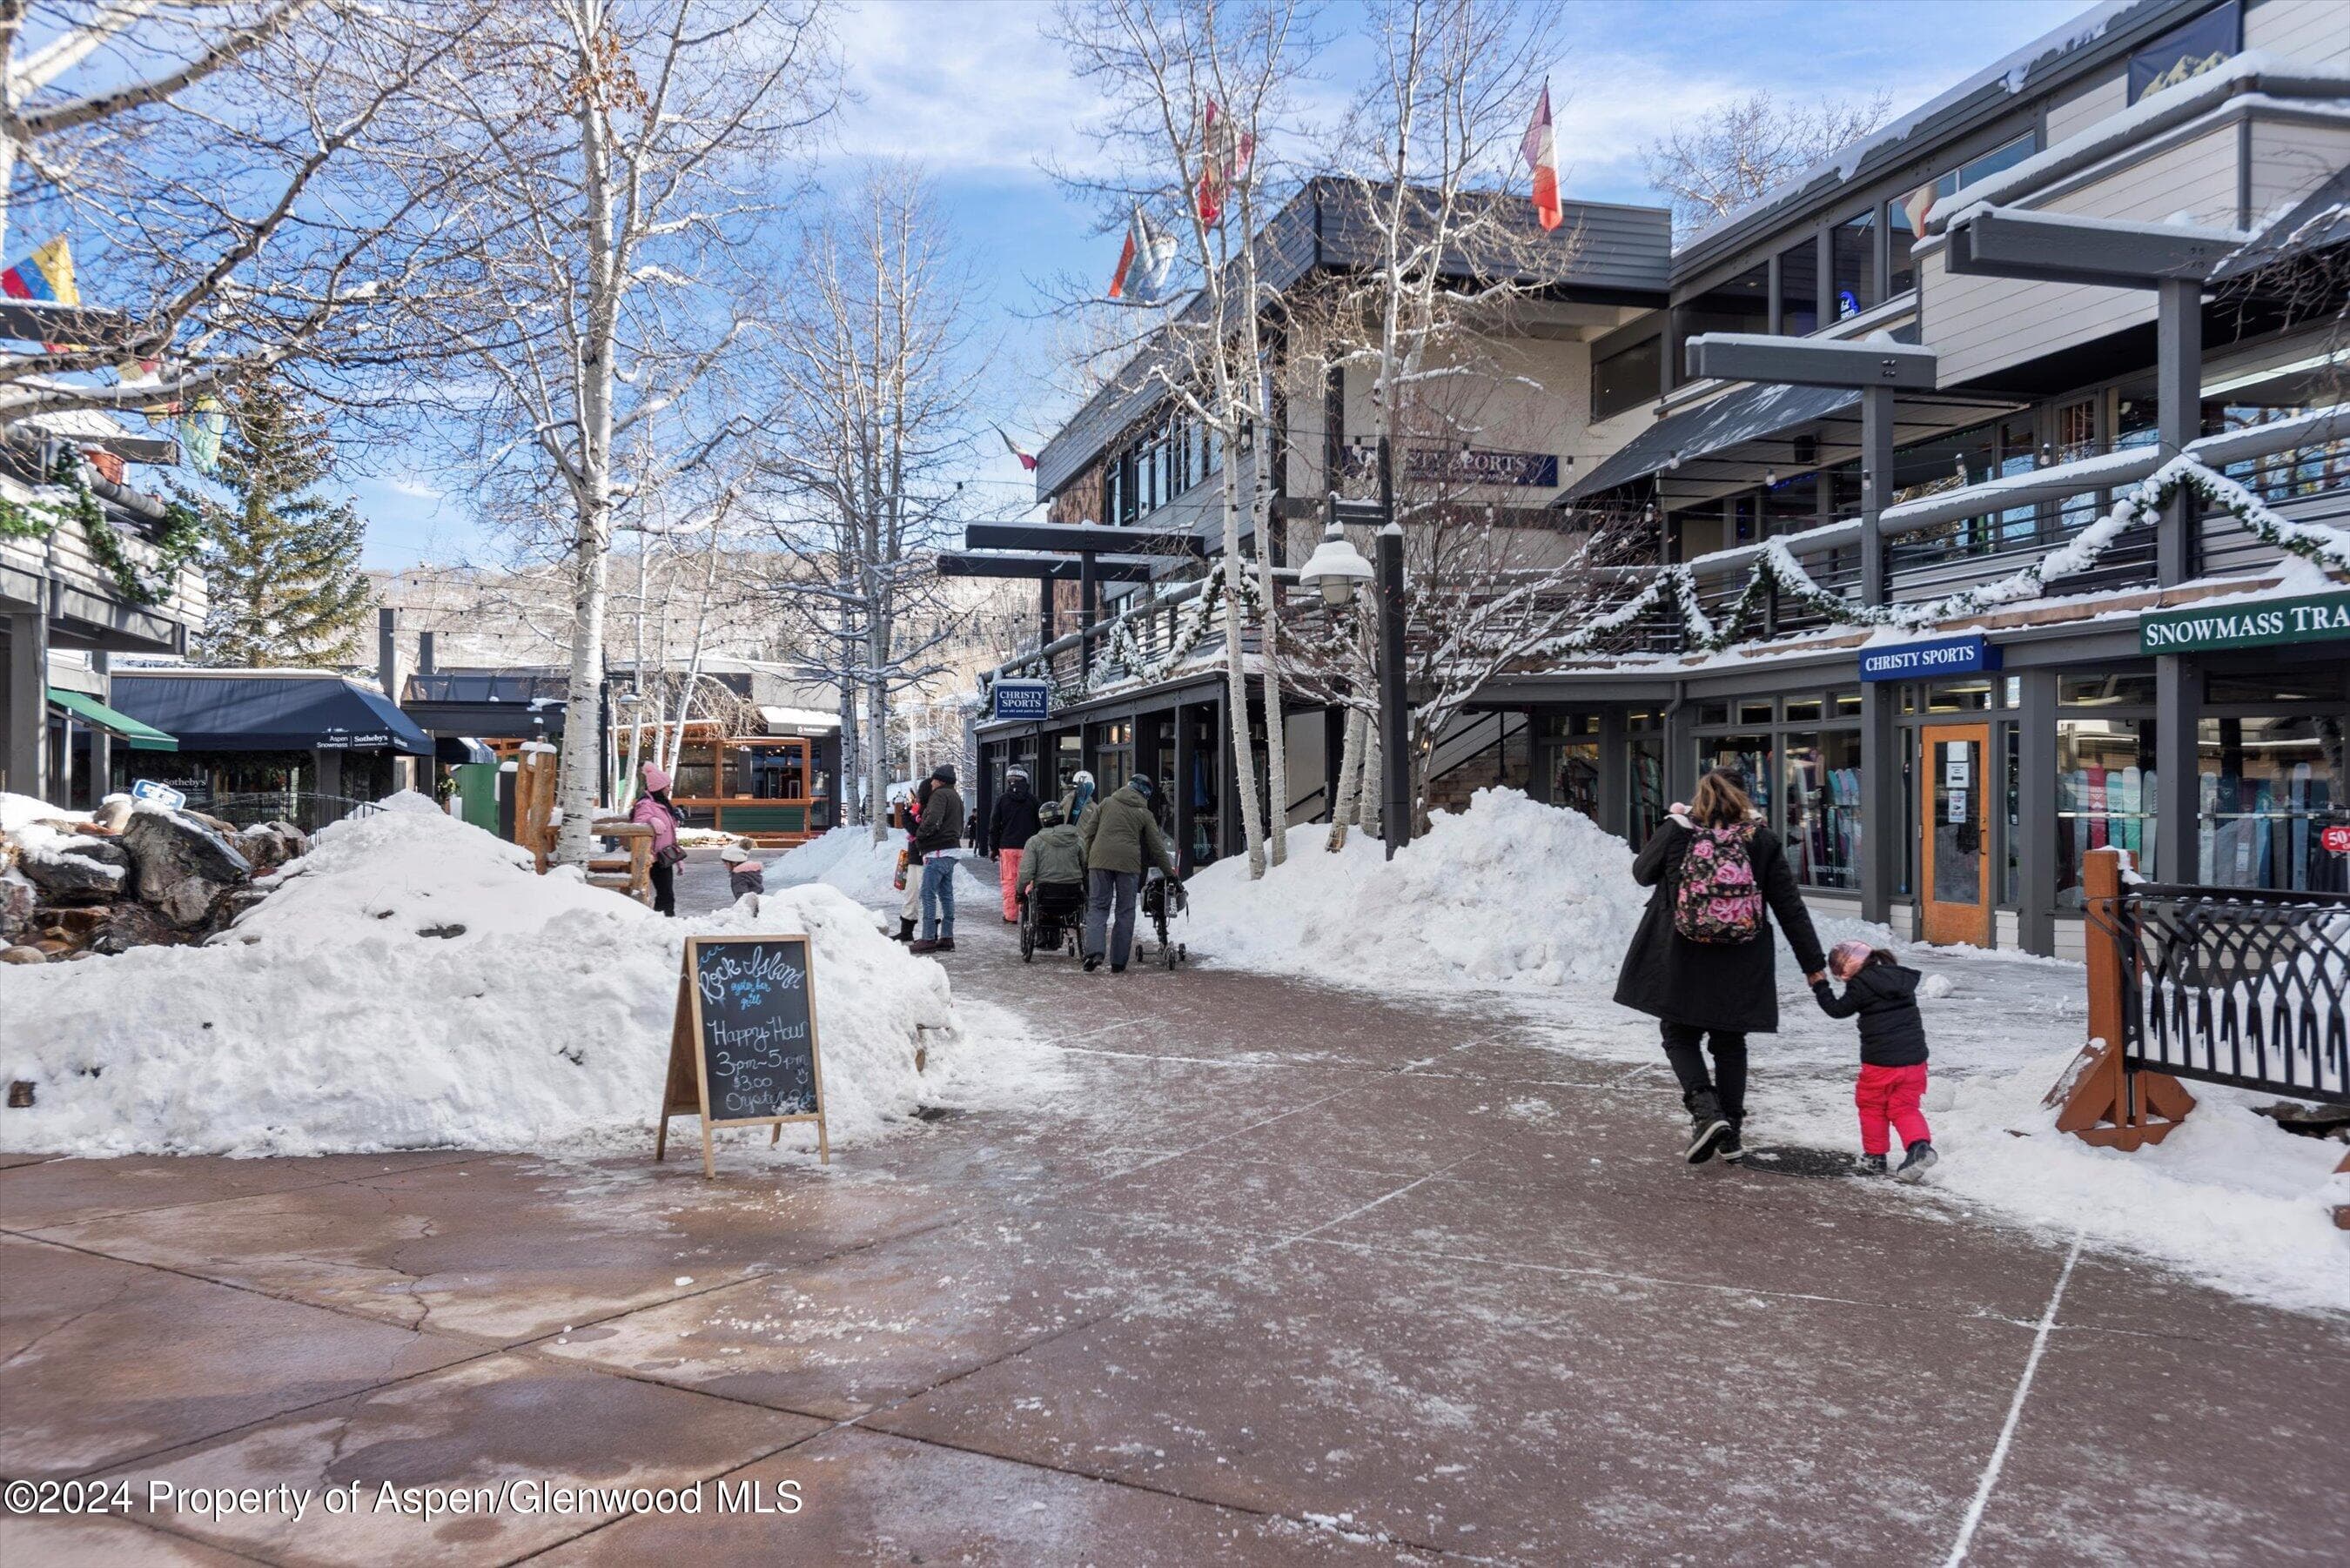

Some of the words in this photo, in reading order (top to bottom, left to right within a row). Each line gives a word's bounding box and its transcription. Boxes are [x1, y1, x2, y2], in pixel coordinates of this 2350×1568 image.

[2146, 612, 2284, 647] SNOWMASS
[2290, 604, 2350, 633] TRA
[1865, 652, 1920, 672] CHRISTY
[1922, 645, 1975, 666] SPORTS
[999, 690, 1044, 700] CHRISTY
[1002, 699, 1041, 707] SPORTS
[353, 734, 388, 743] Sotheby's
[163, 778, 207, 788] Sotheby's
[699, 957, 742, 1005] Rock
[742, 945, 806, 988] Island
[707, 1020, 770, 1052] Happy
